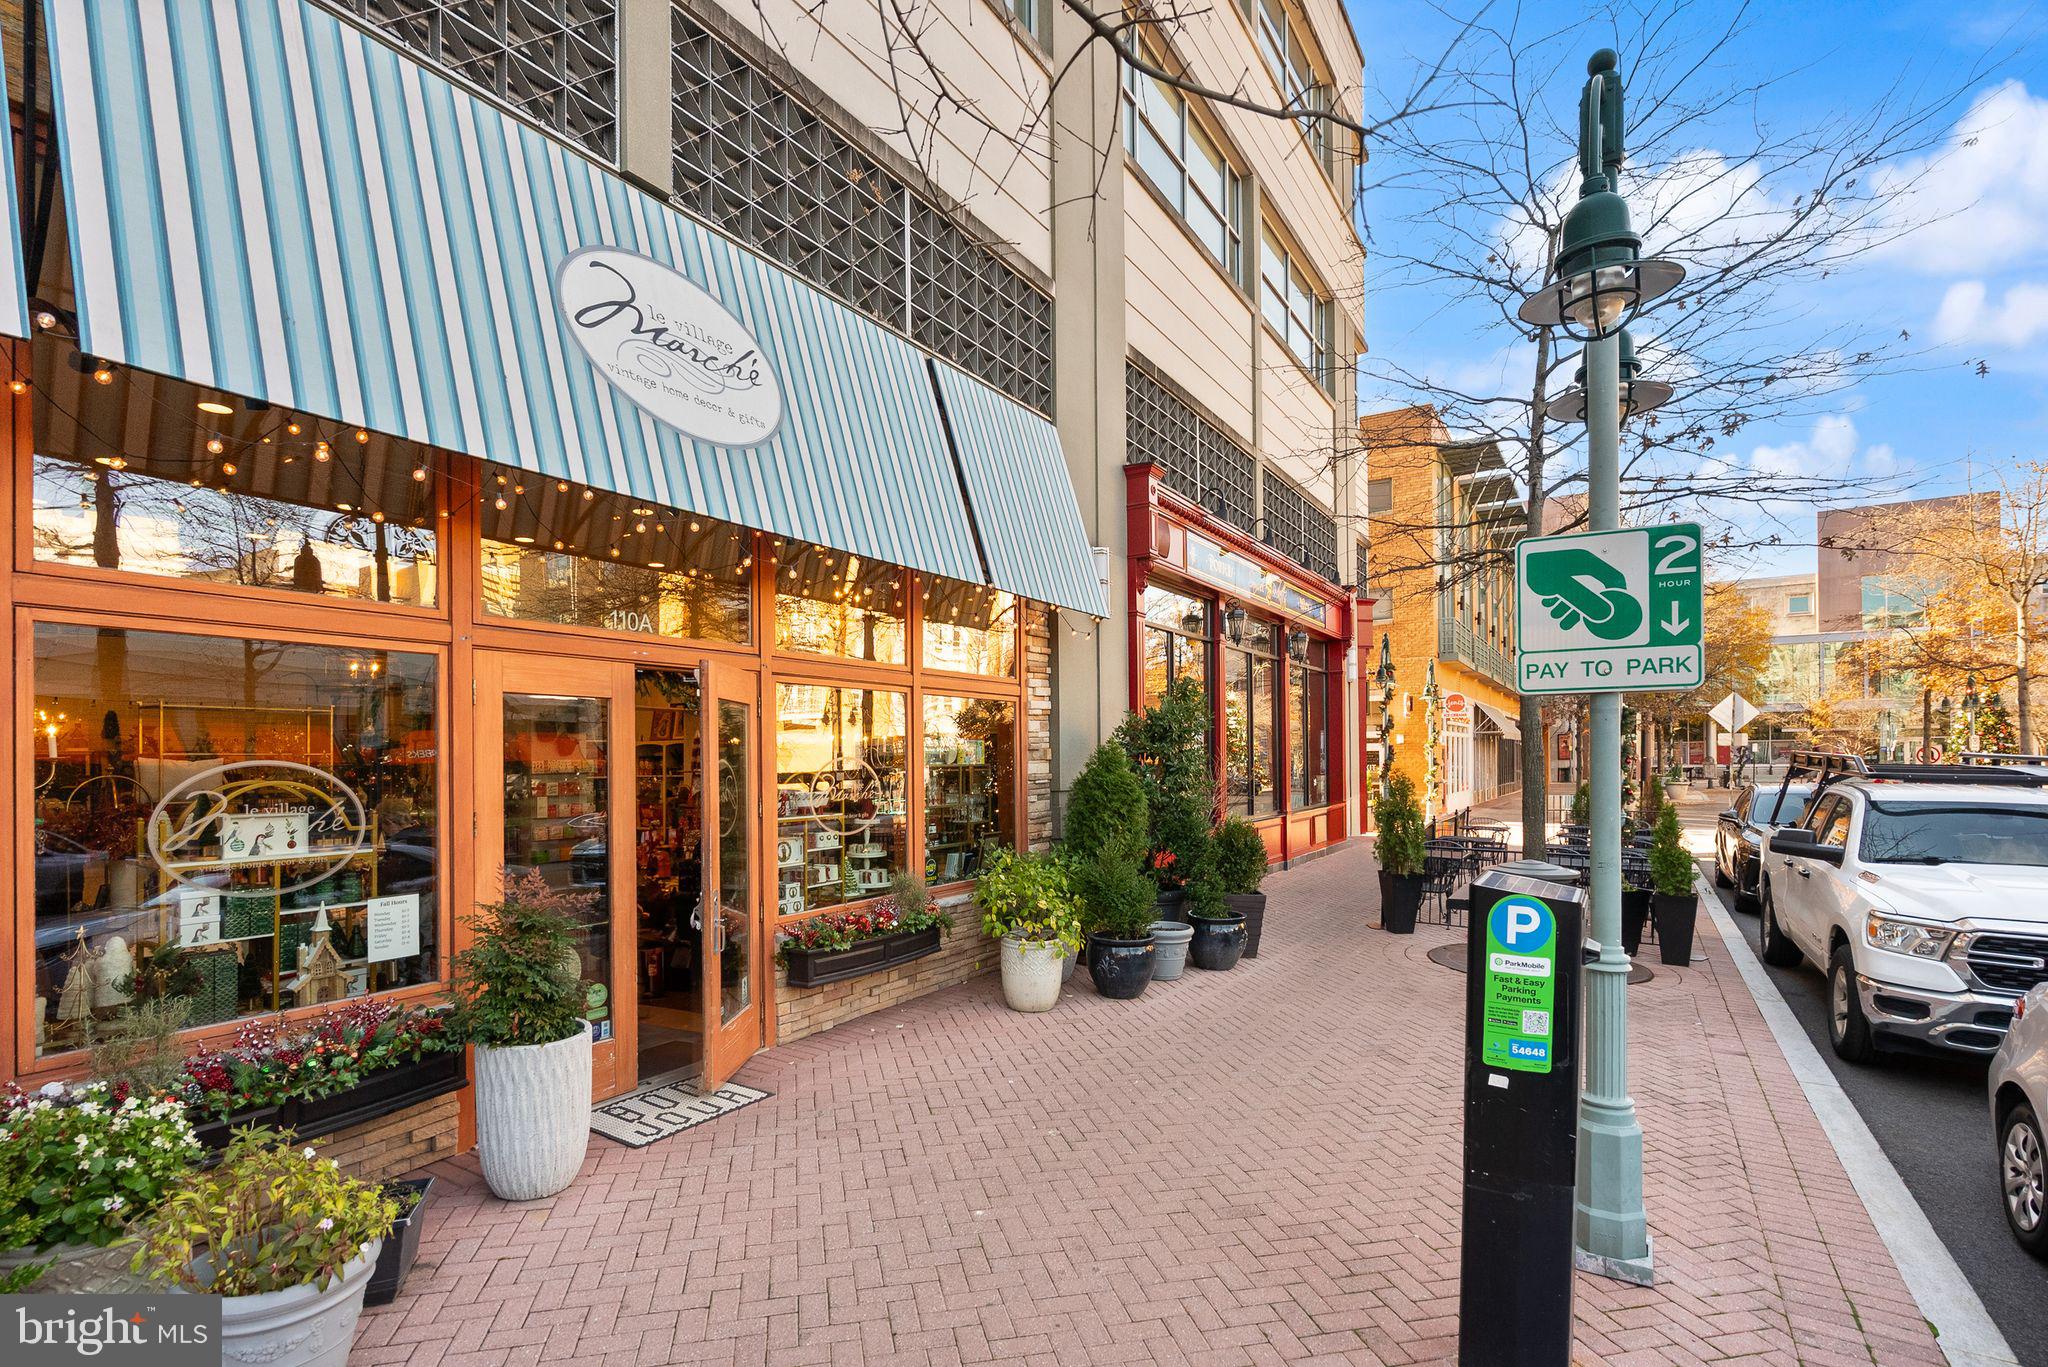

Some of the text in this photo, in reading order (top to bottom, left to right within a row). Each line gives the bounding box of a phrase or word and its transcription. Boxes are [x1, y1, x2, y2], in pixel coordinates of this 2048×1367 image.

[647, 304, 734, 355] le village
[606, 362, 658, 390] vintage
[661, 381, 690, 402] home
[727, 408, 736, 418] &
[738, 412, 767, 430] gifts
[1654, 535, 1697, 576] 2
[1658, 579, 1691, 589] HOUR
[610, 609, 653, 633] 110A
[1526, 655, 1692, 680] PAY TO PARK
[243, 802, 315, 815] le village
[239, 860, 268, 870] home
[270, 857, 296, 867] decor
[308, 856, 328, 867] gifts
[1506, 905, 1541, 945] P
[1505, 960, 1545, 970] ParkMobile
[1493, 974, 1513, 984] Fast
[1523, 978, 1546, 988] Easy
[1502, 984, 1537, 997] Parking
[1496, 992, 1542, 1004] Payments
[1512, 1045, 1546, 1057] 54648
